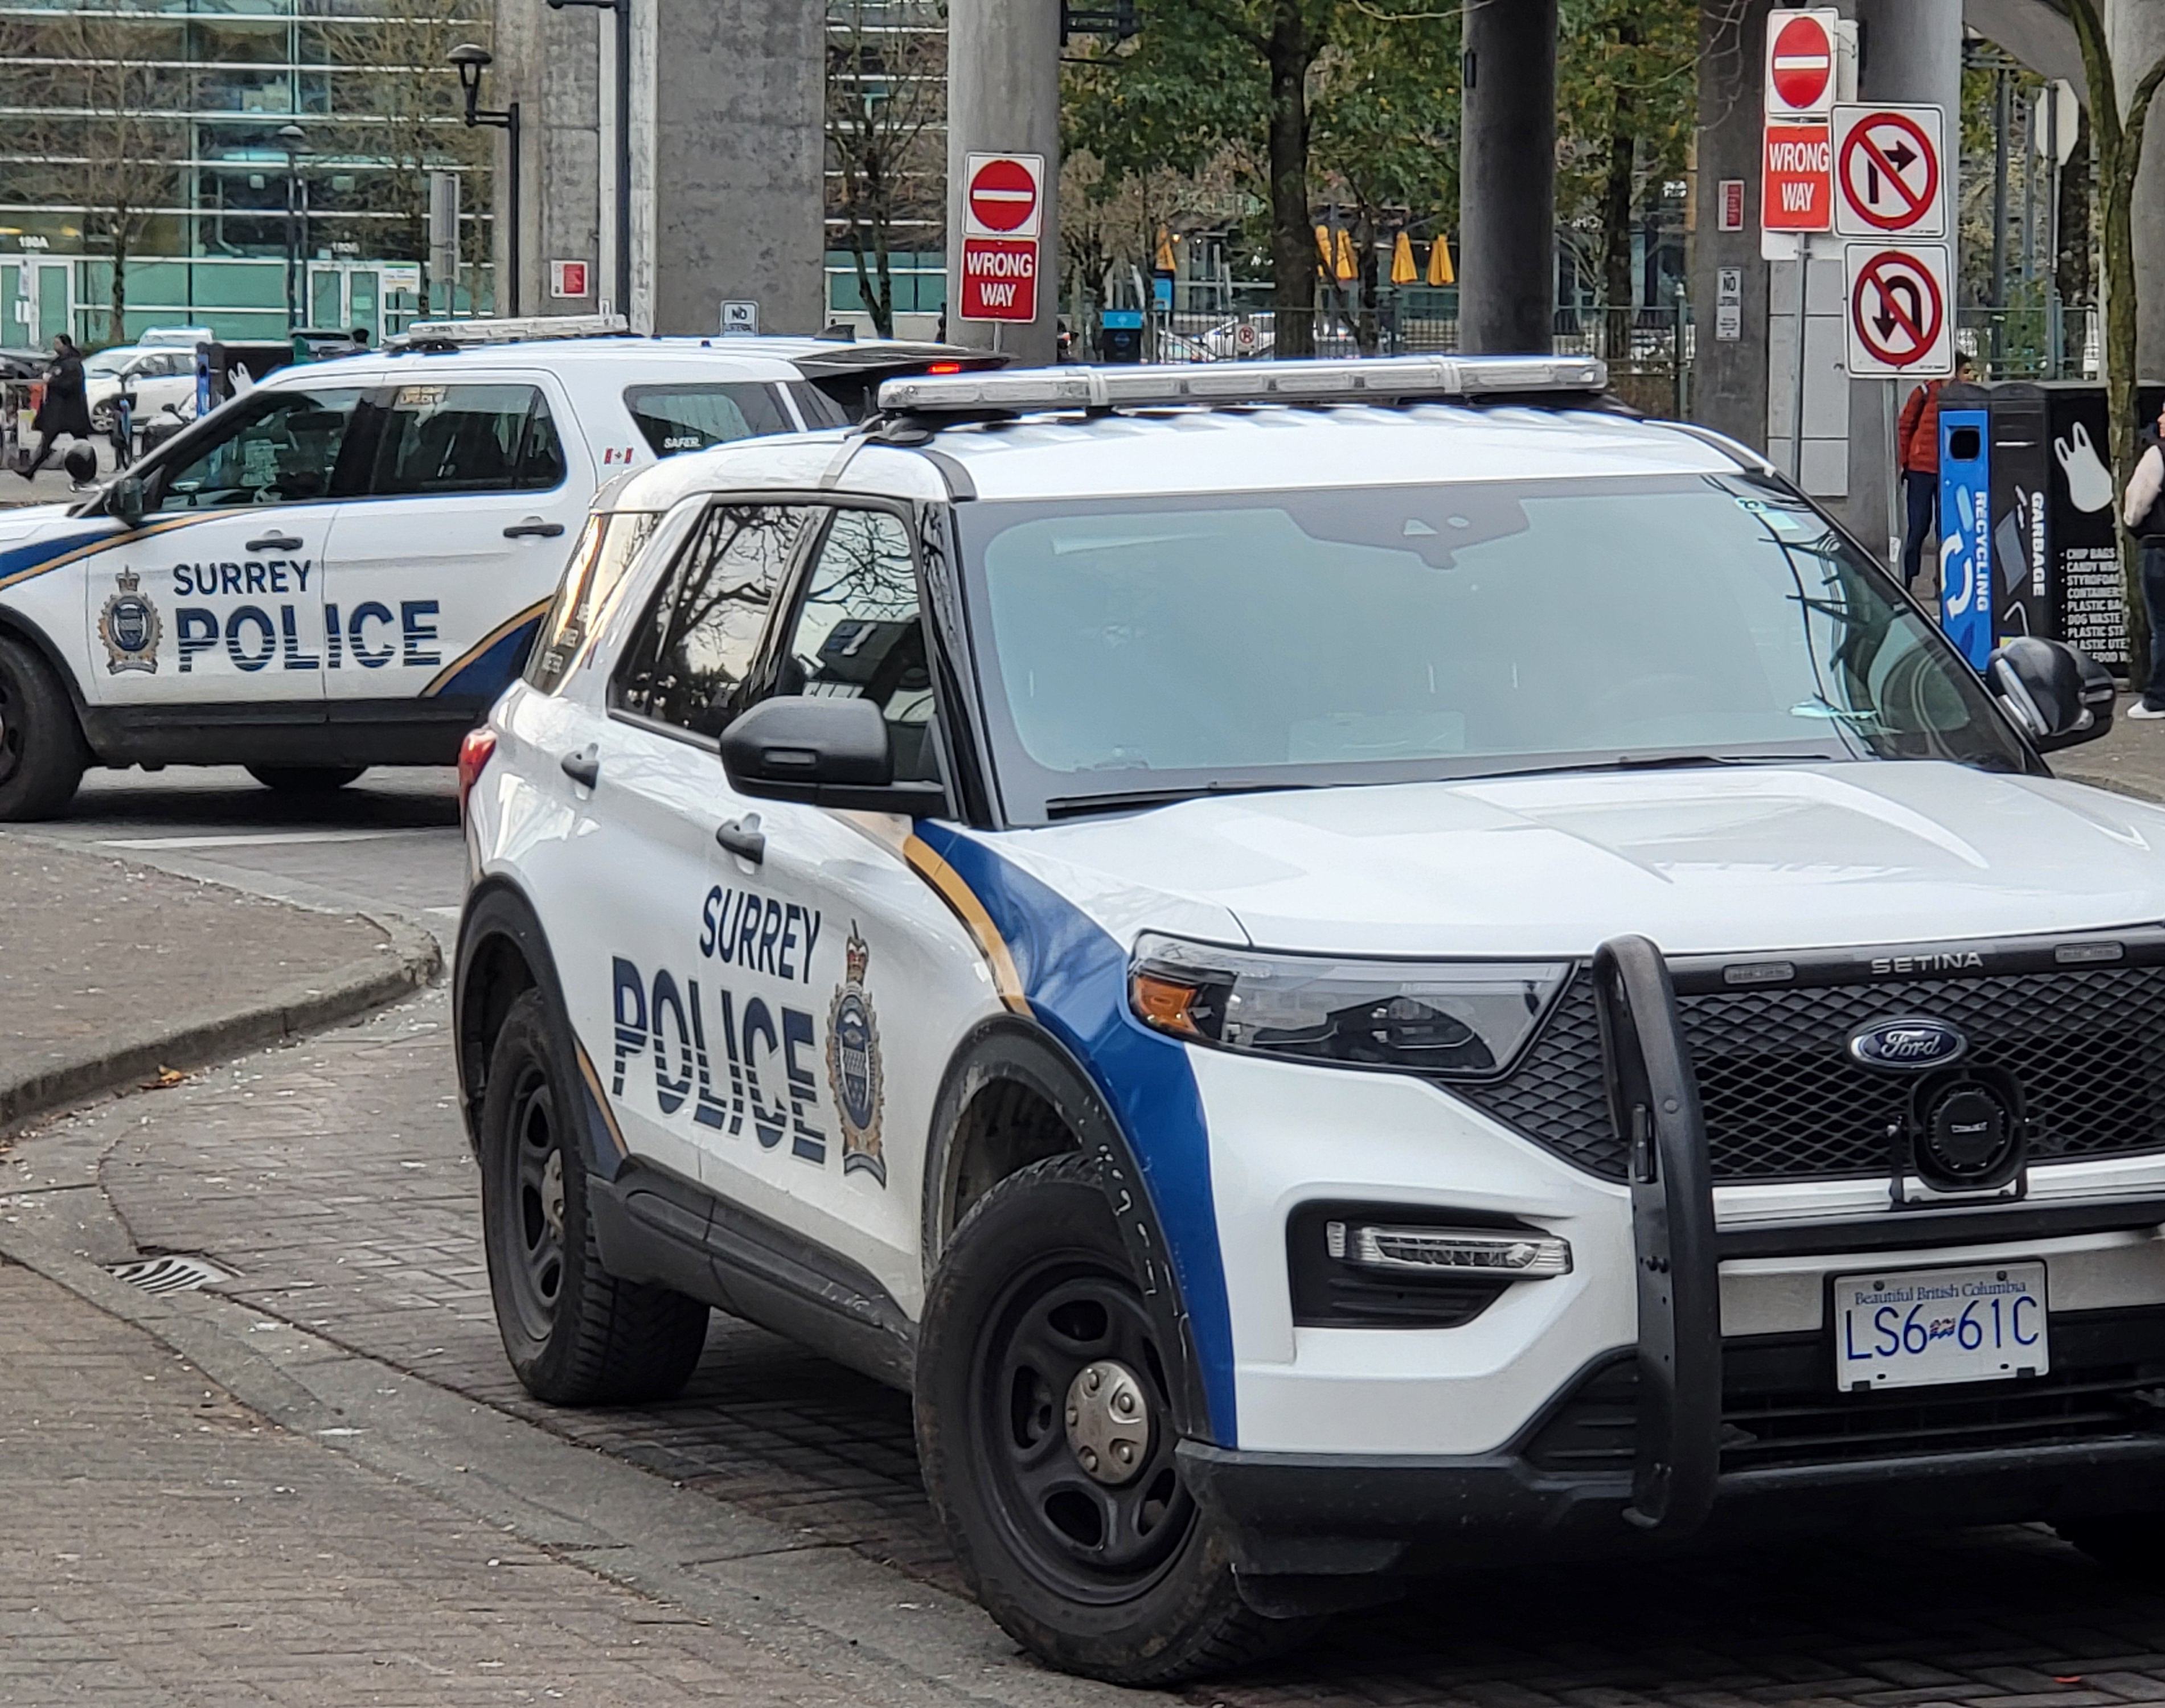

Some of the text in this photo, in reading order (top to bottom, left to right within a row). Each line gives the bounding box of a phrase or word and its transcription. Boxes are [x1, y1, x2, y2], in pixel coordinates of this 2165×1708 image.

[1769, 142, 1830, 173] WRONG
[1782, 182, 1815, 212] WAY
[967, 251, 1033, 277] WRONG
[980, 282, 1016, 307] WAY
[732, 306, 748, 320] NO
[1975, 491, 1988, 611] RECYCLING
[2031, 491, 2045, 597] GARBAGE
[173, 560, 311, 596] SURREY
[2067, 600, 2107, 613] PLASTIC
[2067, 613, 2121, 625] DOG WASTE
[175, 600, 441, 672] POLICE
[2067, 626, 2107, 638] PLASTIC
[700, 885, 821, 984] SURREY
[1871, 951, 1984, 974] SETINA
[1880, 1029, 1941, 1058] Ford
[612, 955, 826, 1165] POLICE
[1854, 1280, 2027, 1305] Beautiful British Columbia
[1846, 1295, 2040, 1361] LS6 61C
